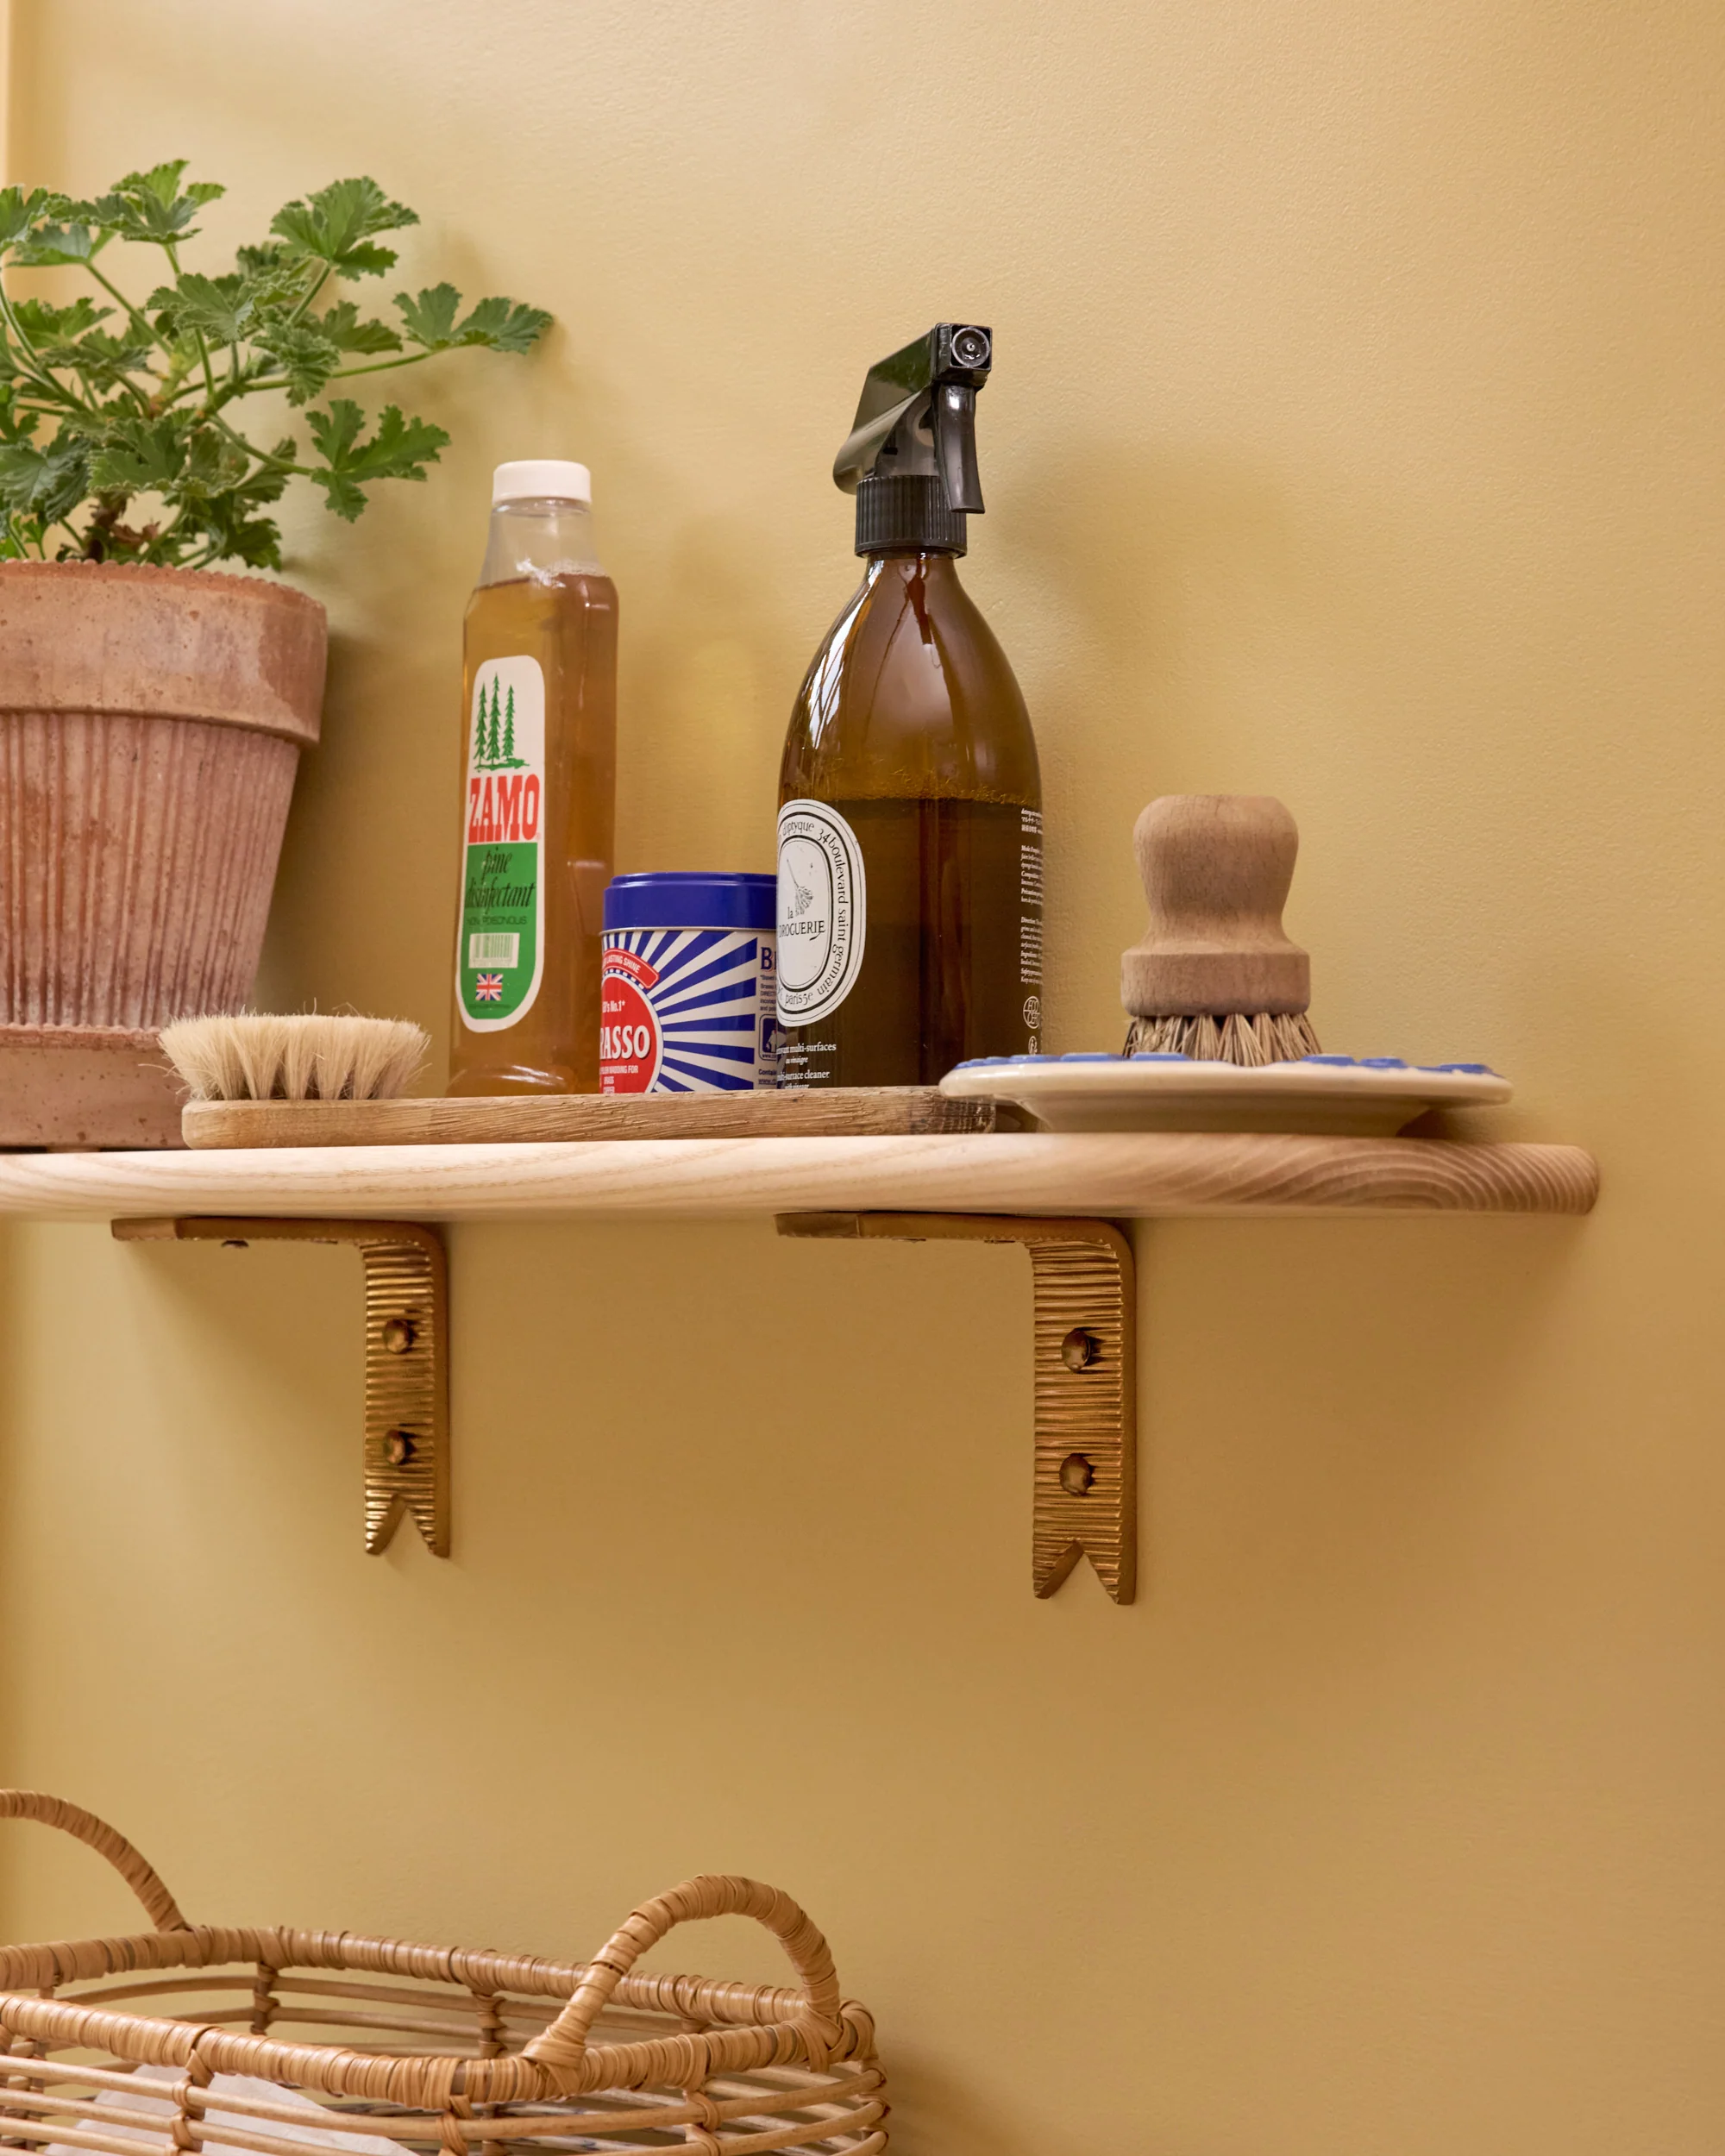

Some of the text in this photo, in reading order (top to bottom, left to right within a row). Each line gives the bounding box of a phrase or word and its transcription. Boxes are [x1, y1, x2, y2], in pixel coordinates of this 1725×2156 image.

[468, 774, 539, 843] ZAMO
[783, 821, 814, 836] diptyque
[481, 846, 512, 884] pine
[465, 876, 535, 914] disinfectant
[787, 906, 794, 919] la
[838, 908, 849, 941] saint
[623, 956, 642, 974] SHINE
[816, 943, 844, 995] germain
[628, 1065, 639, 1074] FOR
[804, 1069, 830, 1079] cleaner
